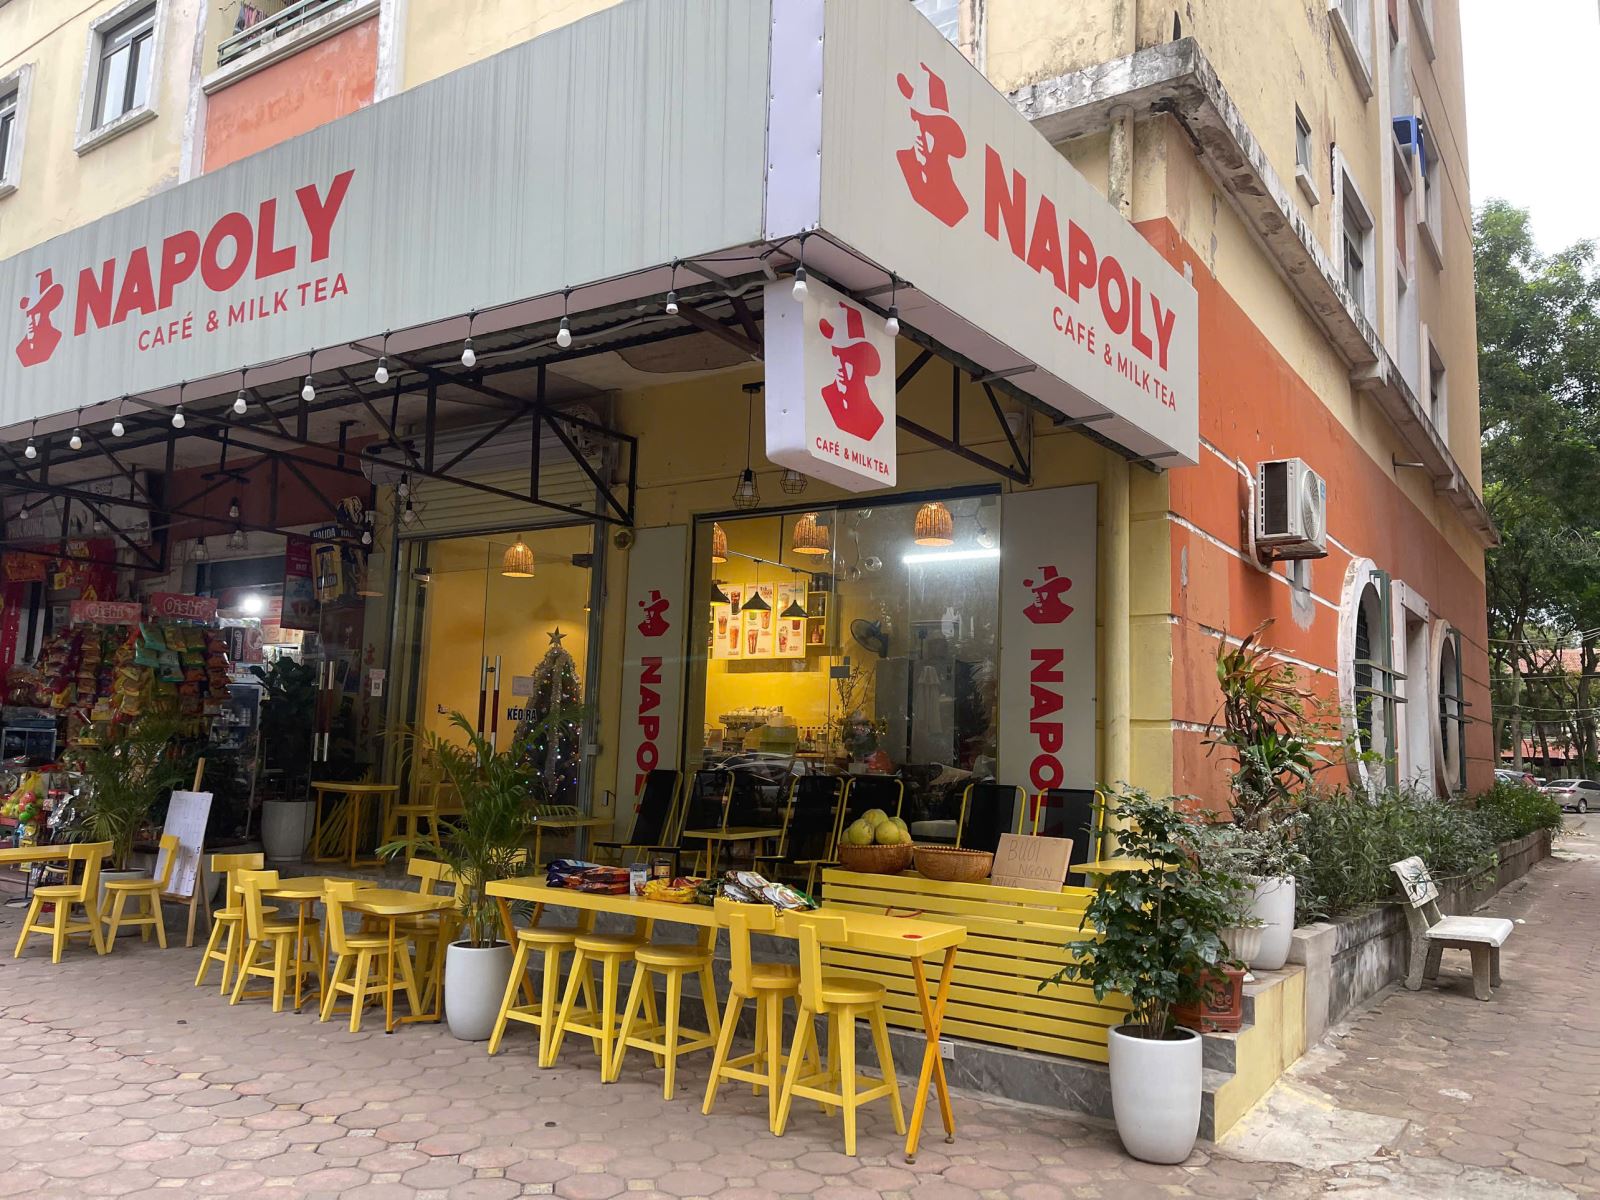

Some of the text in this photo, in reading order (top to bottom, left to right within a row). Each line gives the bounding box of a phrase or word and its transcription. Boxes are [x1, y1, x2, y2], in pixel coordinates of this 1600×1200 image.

[74, 168, 355, 337] NAPOLY
[984, 144, 1177, 372] NAPOLY
[137, 271, 350, 352] CAFÉ & MILK TEA
[1052, 304, 1177, 412] CAFÉ & MILK TEA
[816, 437, 890, 476] CAFÉ & MILK TEA
[313, 527, 336, 539] HALIDA
[164, 597, 202, 617] Oishi
[507, 705, 537, 721] KÉO RA
[632, 656, 664, 814] NAPOL
[1029, 648, 1065, 836] NAPOL
